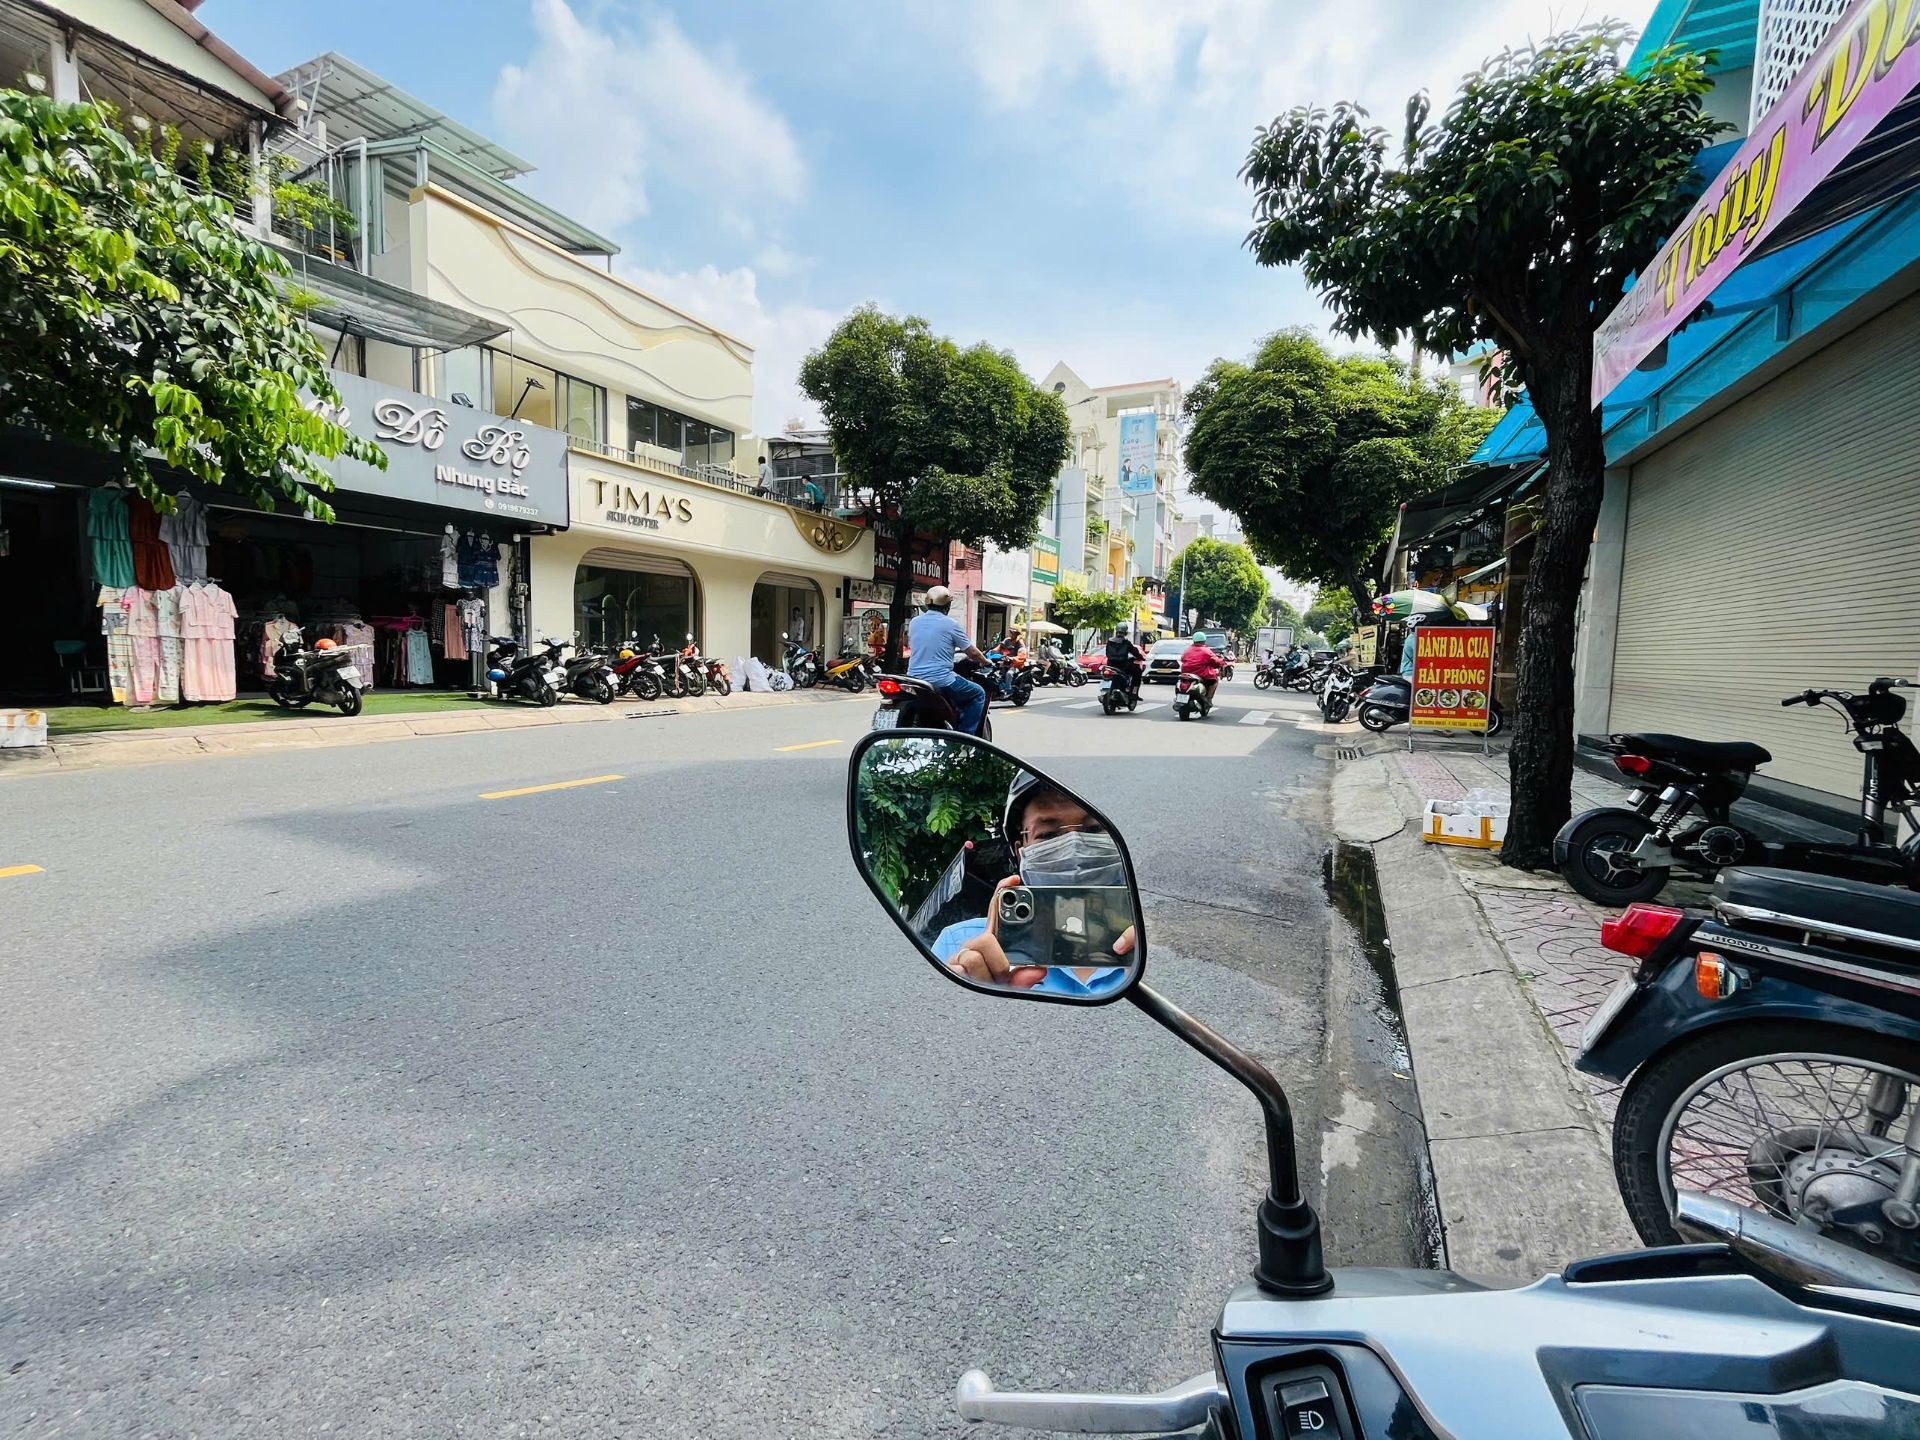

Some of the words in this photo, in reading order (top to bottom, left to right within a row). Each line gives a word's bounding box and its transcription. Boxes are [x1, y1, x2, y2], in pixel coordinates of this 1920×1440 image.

[462, 425, 530, 477] Bộ
[437, 465, 495, 494] Nhung
[588, 478, 693, 523] TIMA'S
[606, 510, 627, 523] SKIN
[627, 514, 659, 530] CENTER
[912, 556, 927, 576] TRÀ
[1417, 630, 1448, 658] BÁNH
[1449, 636, 1465, 658] ĐA
[1467, 636, 1490, 658] CUA
[1418, 661, 1441, 684] HẢI
[1443, 664, 1486, 685] PHÒNG
[1715, 934, 1771, 953] HONDA
